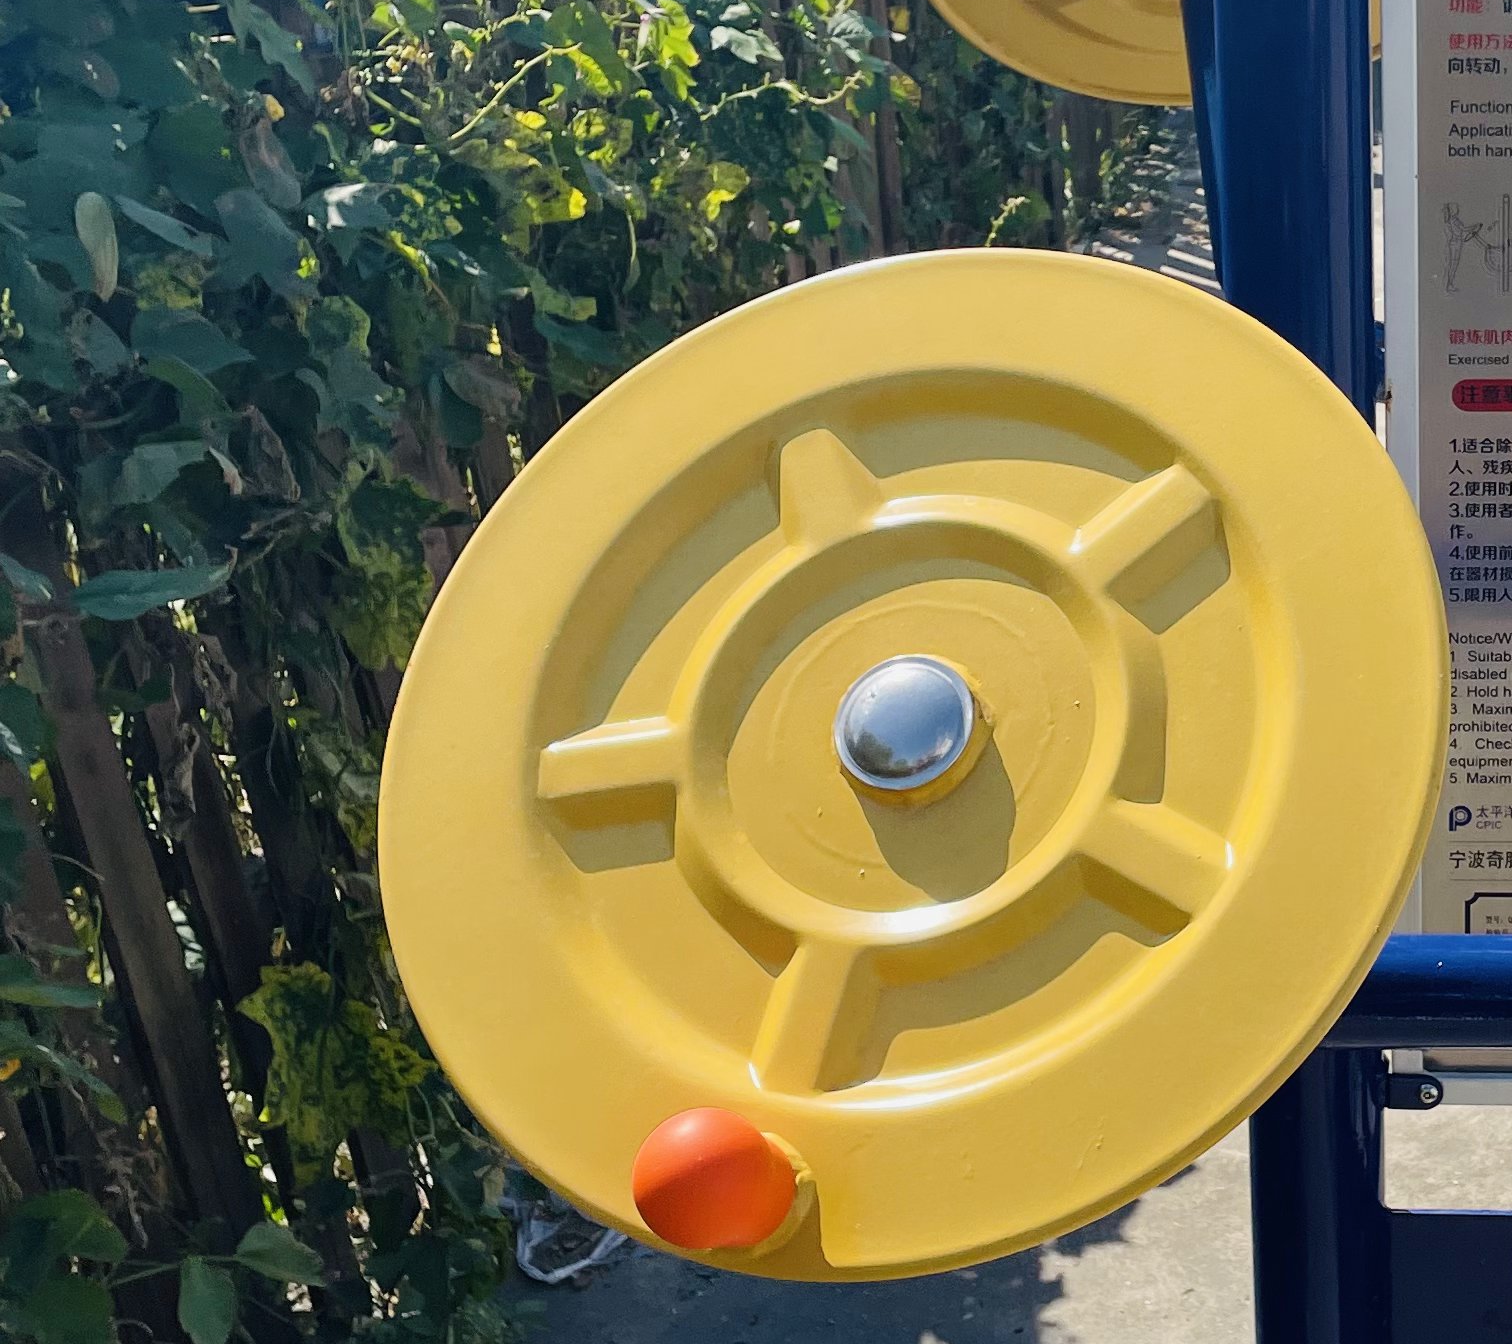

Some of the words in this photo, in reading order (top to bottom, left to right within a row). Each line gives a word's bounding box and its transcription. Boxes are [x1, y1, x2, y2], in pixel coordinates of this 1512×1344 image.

[1448, 144, 1480, 157] both
[1449, 354, 1509, 365] Exercised
[1450, 524, 1473, 540] 作。
[1450, 669, 1507, 681] disabled
[1467, 686, 1498, 697] Hold
[1476, 821, 1502, 829] CPIC
